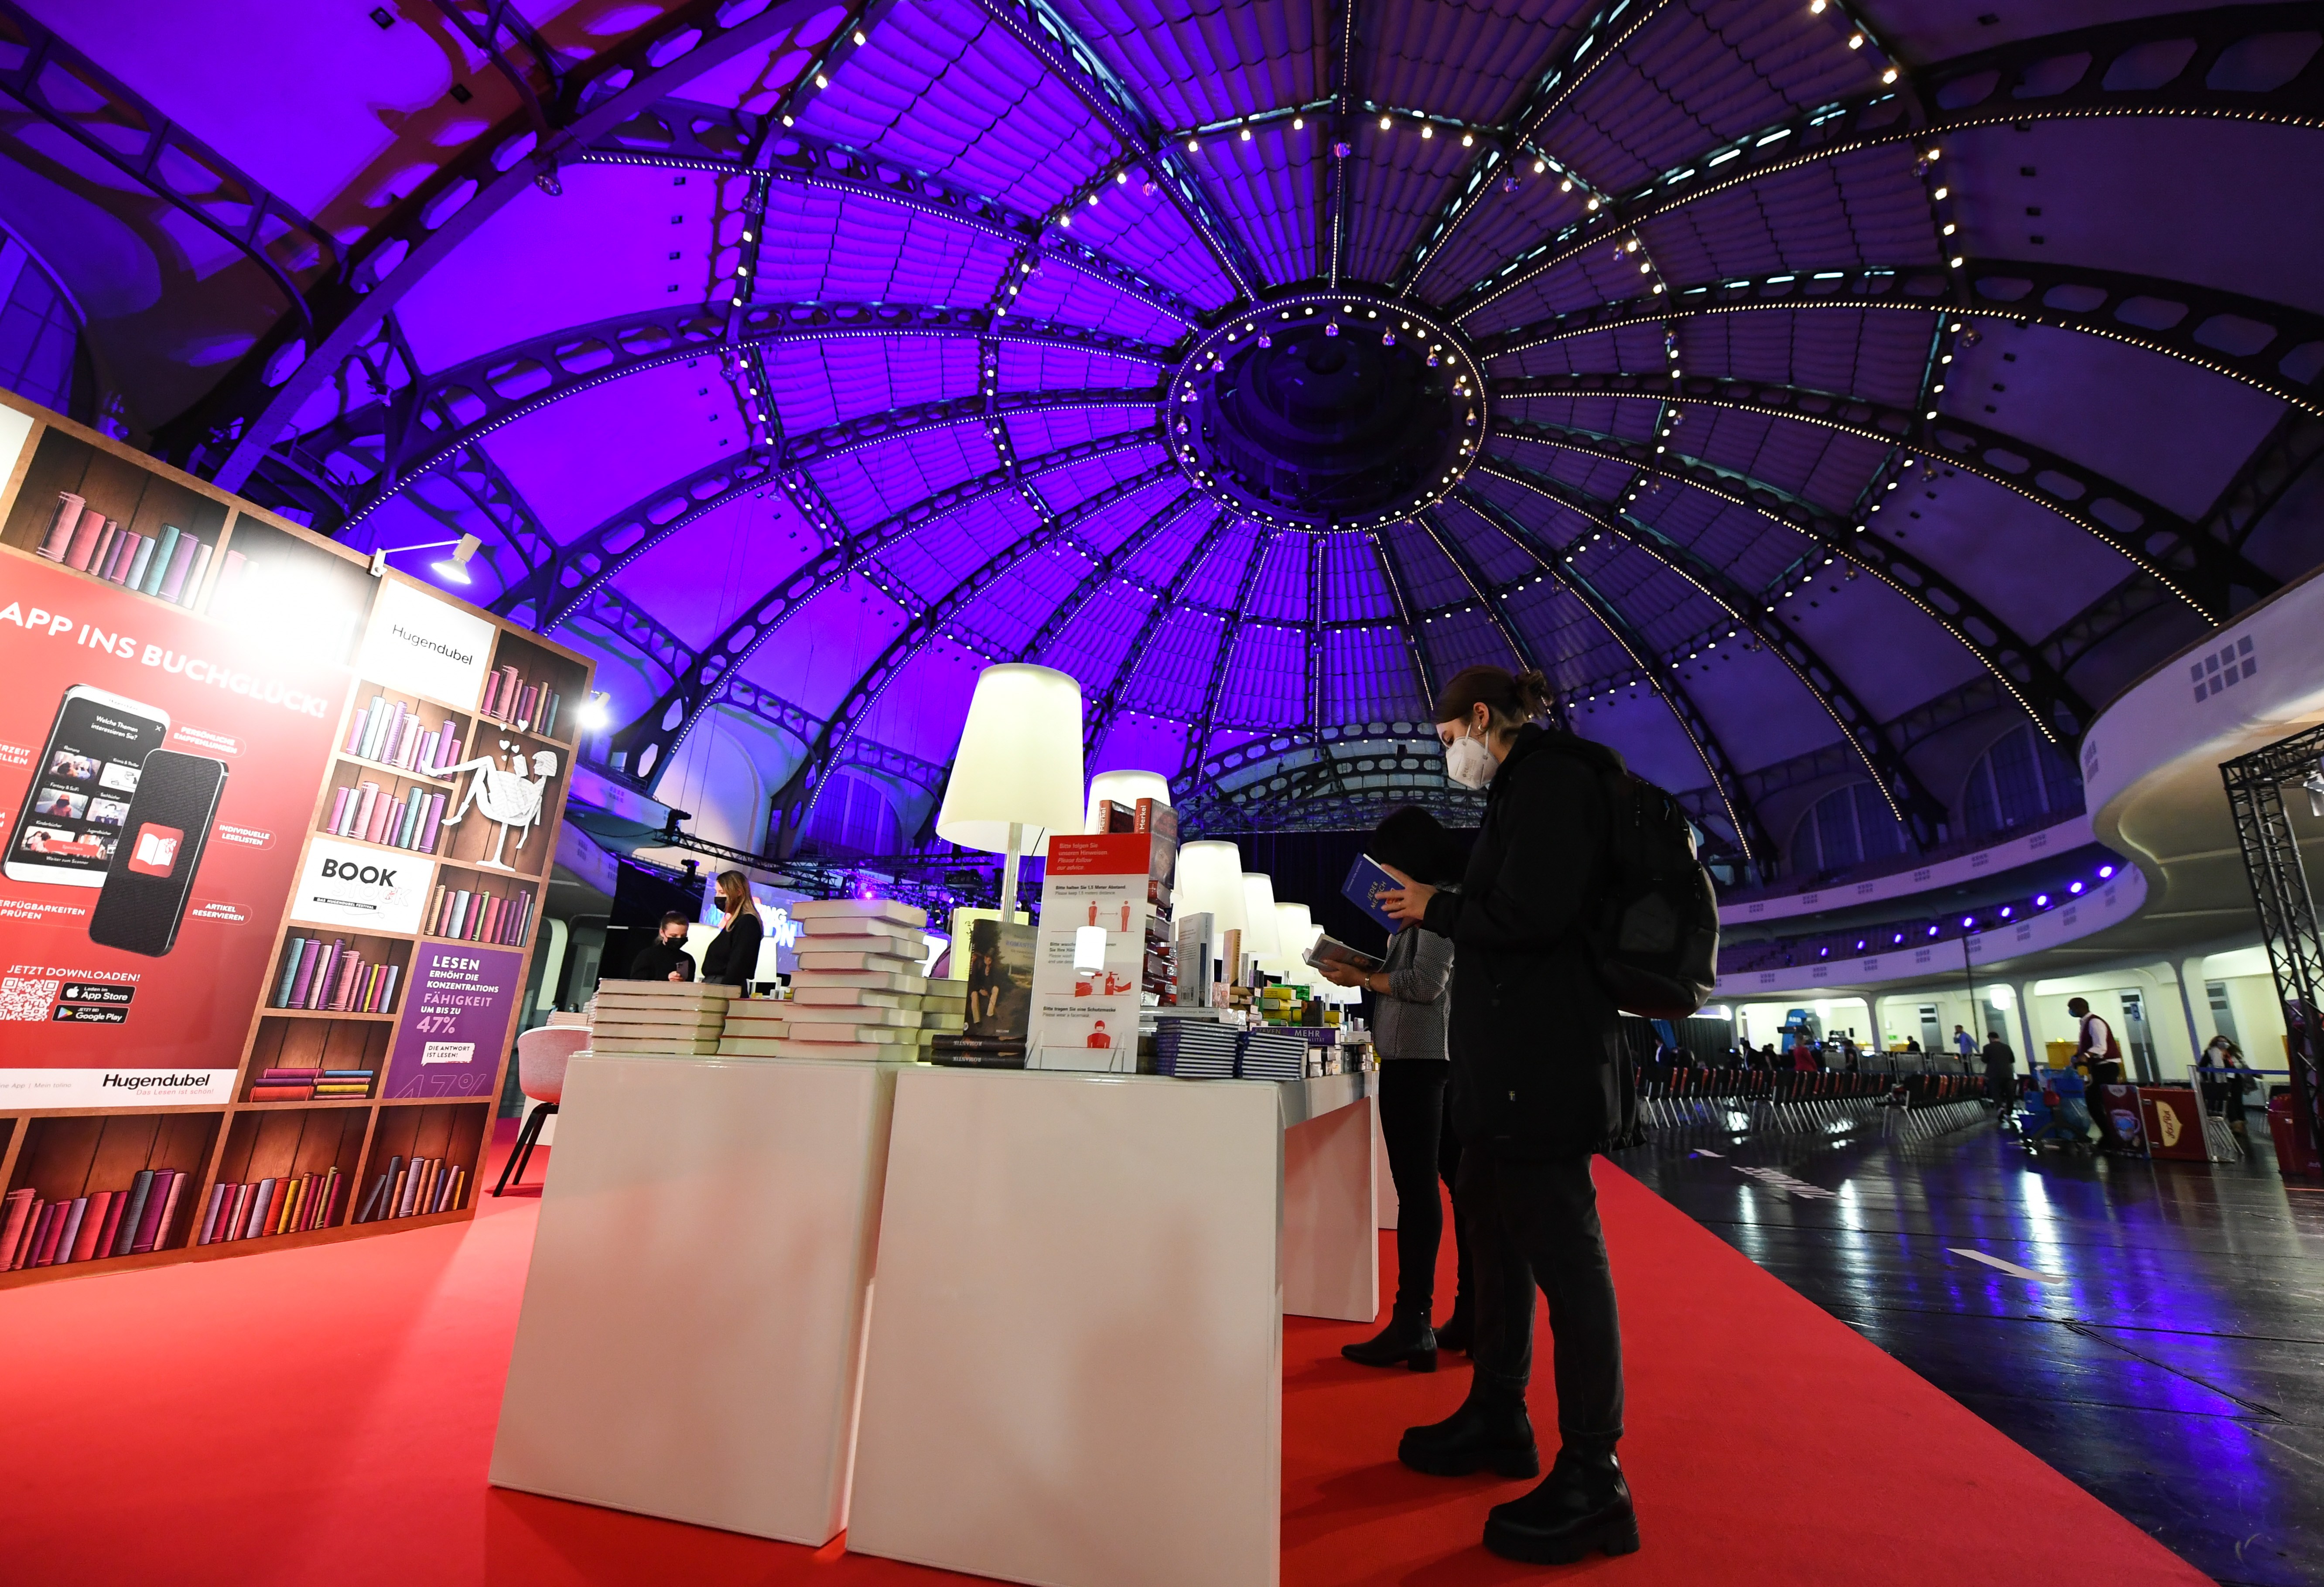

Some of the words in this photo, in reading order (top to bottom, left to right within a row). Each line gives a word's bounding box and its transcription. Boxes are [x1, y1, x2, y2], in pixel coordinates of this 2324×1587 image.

[393, 624, 473, 665] Hugendubel
[0, 601, 73, 636] APP
[77, 624, 137, 659] INS
[141, 644, 328, 718] BUCHGLÜCK!
[91, 723, 126, 737] interessieren
[125, 732, 138, 741] Sie?
[96, 715, 116, 727] Welche
[117, 721, 138, 733] Themen
[173, 732, 237, 754] EMPFEHLUNGEN
[181, 726, 236, 746] PERSÖNLICHE
[219, 824, 270, 840] INDIVIDUELLE
[221, 833, 263, 846] LESELISTEN
[321, 858, 397, 887] BOOK
[1366, 881, 1378, 901] JEDER
[1370, 881, 1387, 910] MECH
[0, 909, 42, 920] PRÜFEN
[192, 909, 245, 921] RESERVIEREN
[205, 903, 236, 913] ARTIKEL
[432, 955, 480, 971] LESEN
[7, 964, 44, 975] JETZT
[46, 967, 141, 982] DOWNLOADEN!
[429, 969, 465, 980] ERHÖHT
[465, 973, 479, 981] DIE
[426, 980, 499, 993] KONZENTRATIONS
[80, 992, 102, 1000] App
[103, 992, 128, 1001] Store
[423, 991, 492, 1007] FÄHIGKEIT
[75, 1012, 105, 1021] Google
[106, 1013, 123, 1022] Play
[416, 1016, 456, 1034] 47%
[102, 1074, 210, 1090] Hugendubel
